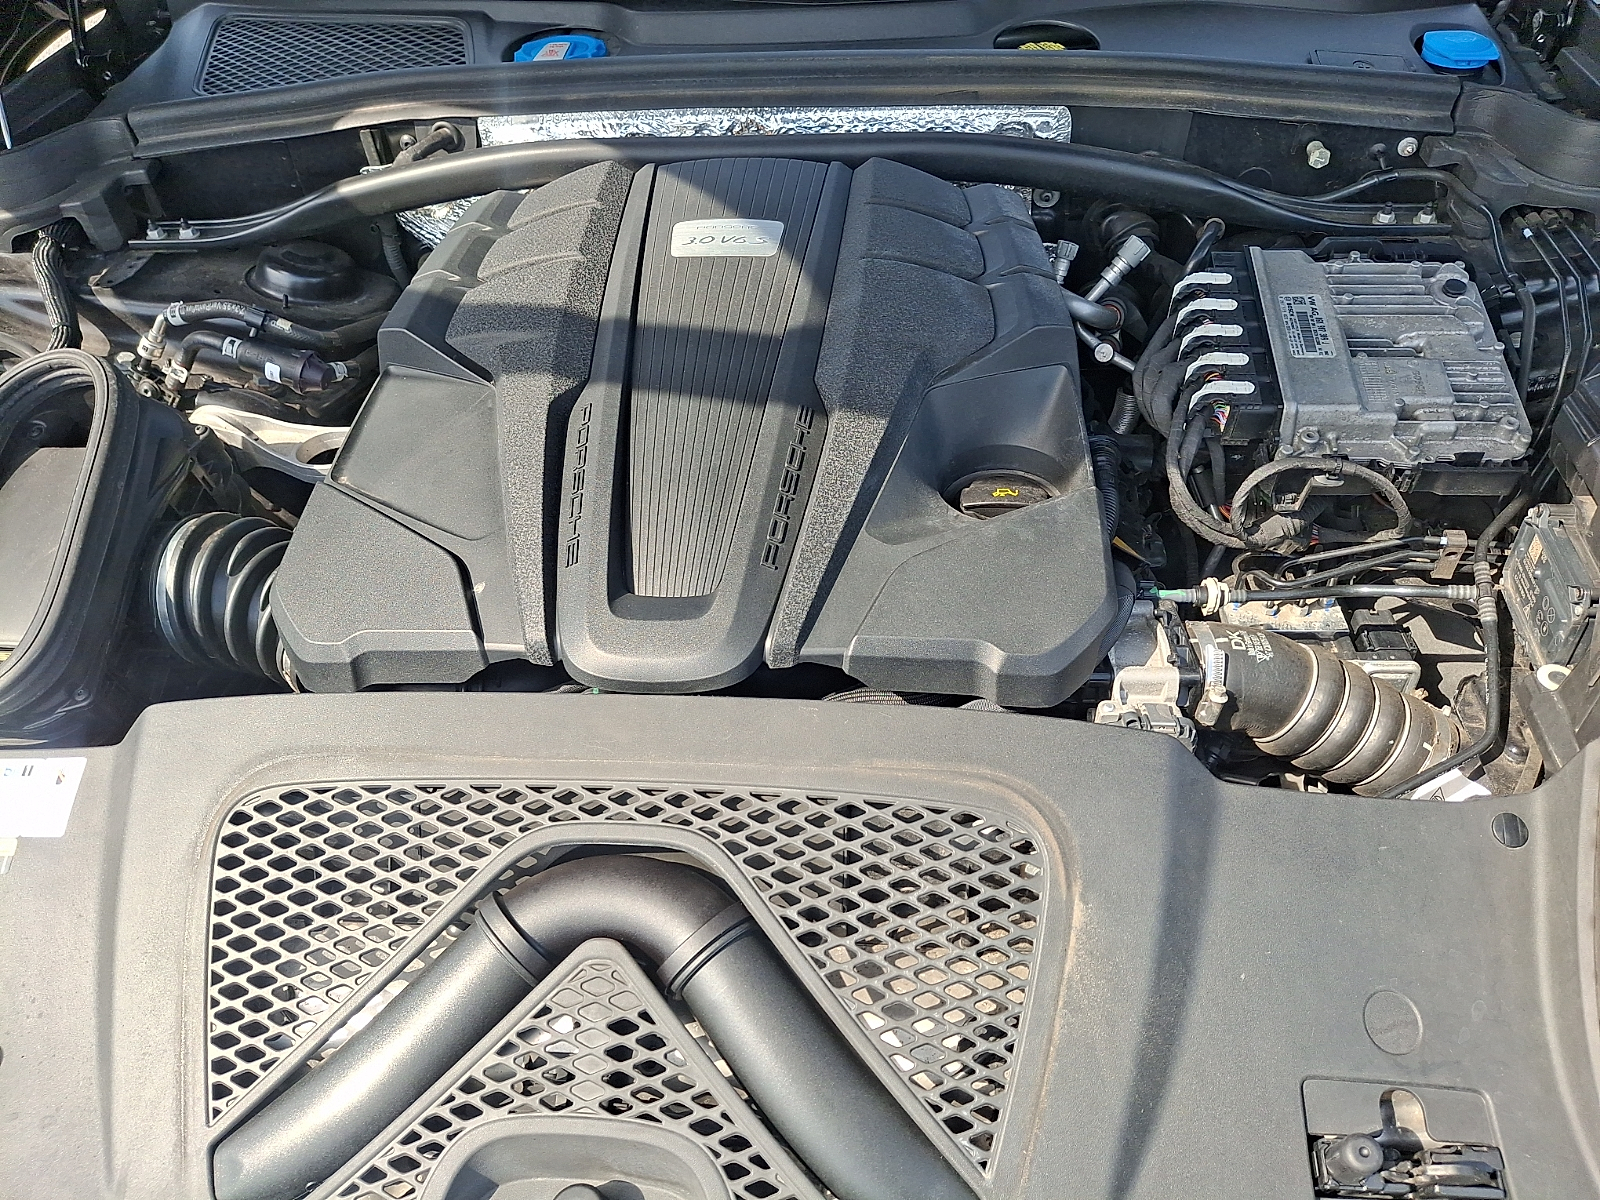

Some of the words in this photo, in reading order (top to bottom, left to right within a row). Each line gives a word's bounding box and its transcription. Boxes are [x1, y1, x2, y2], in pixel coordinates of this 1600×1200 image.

[682, 235, 716, 246] 3.0
[721, 235, 747, 244] V6
[1308, 295, 1317, 306] VW
[1310, 306, 1319, 315] AG
[565, 402, 592, 568] PORSCHE
[760, 404, 815, 571] PORSCHE
[1226, 630, 1246, 650] DK
